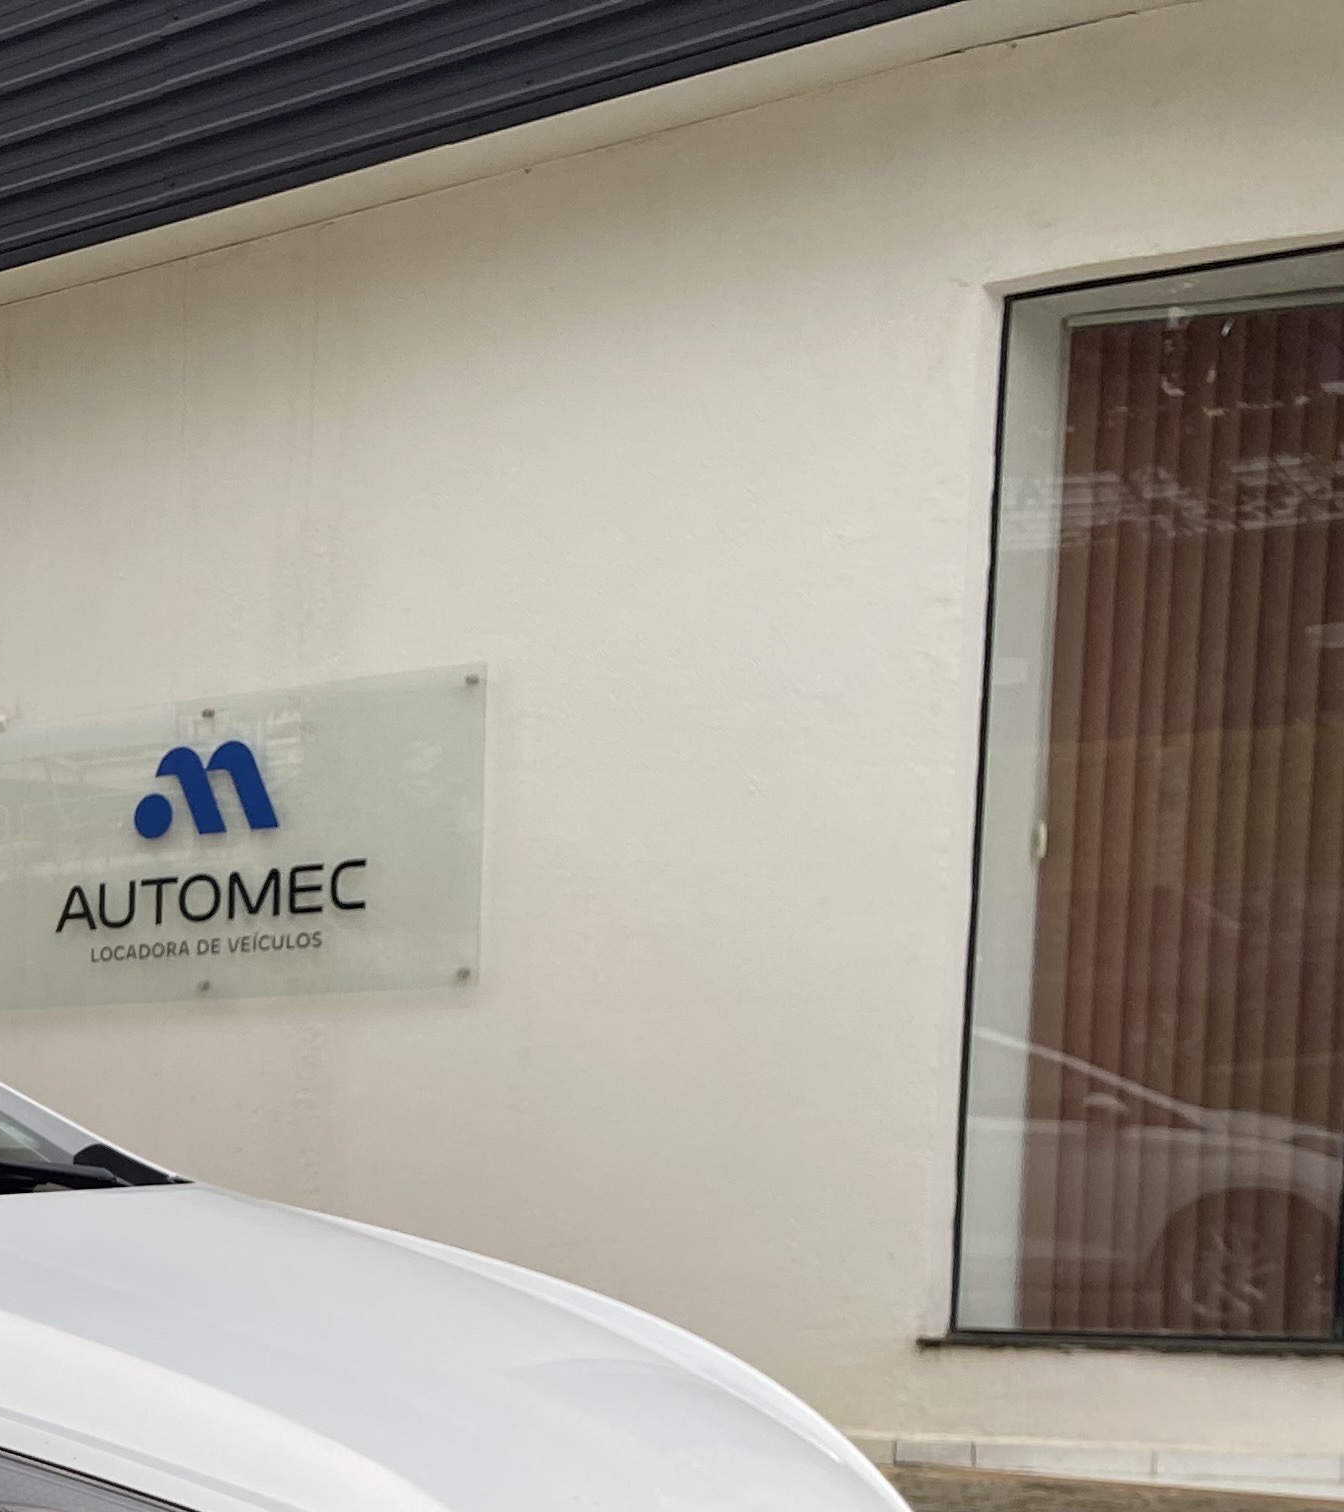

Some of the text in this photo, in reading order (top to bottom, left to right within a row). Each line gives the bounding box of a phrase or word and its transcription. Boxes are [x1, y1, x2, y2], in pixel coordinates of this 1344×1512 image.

[55, 858, 367, 933] AUTOMEC
[90, 931, 323, 963] LOCADORA DE VEÍCULOS
